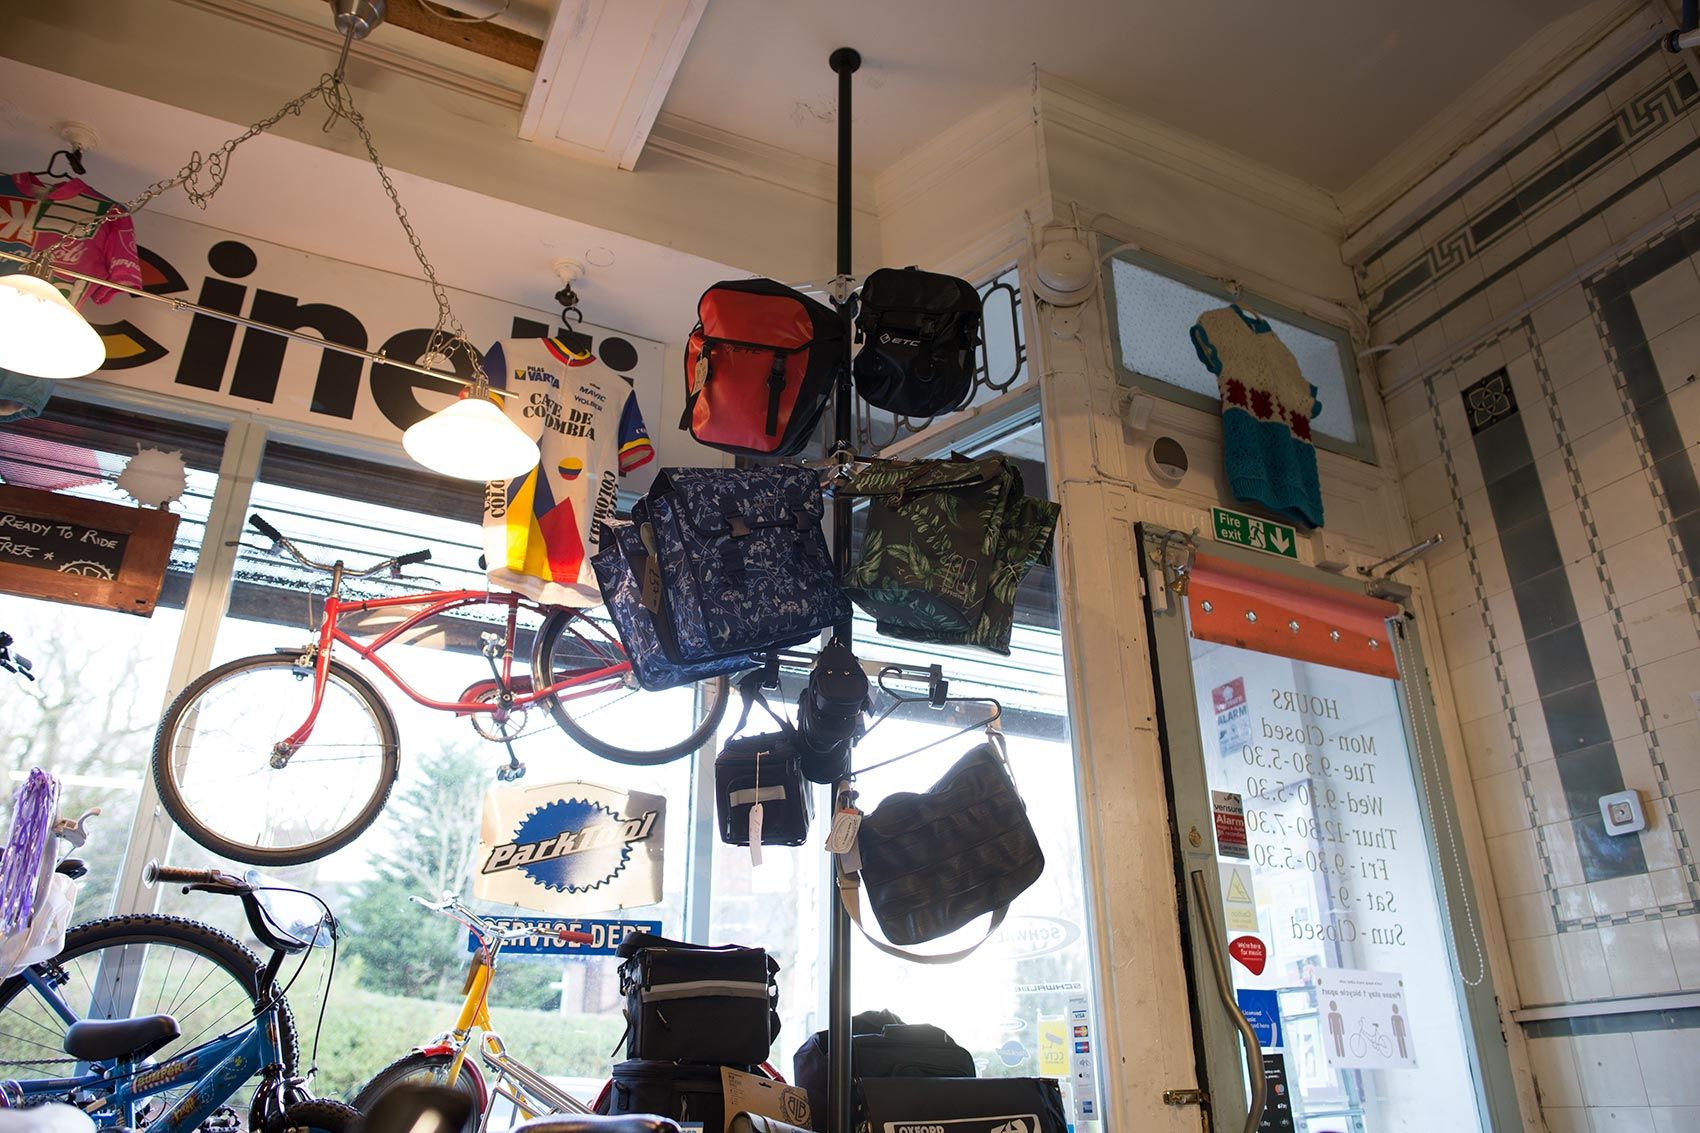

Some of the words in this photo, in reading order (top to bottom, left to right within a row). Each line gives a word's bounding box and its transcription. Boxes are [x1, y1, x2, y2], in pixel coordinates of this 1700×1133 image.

[528, 371, 560, 389] VARTA
[579, 386, 607, 402] MAVIC
[523, 405, 595, 441] COOMBIA
[569, 408, 593, 425] DE
[491, 480, 505, 518] COLO
[1220, 512, 1241, 528] Fire
[1221, 528, 1242, 541] exit
[1217, 705, 1247, 726] ALARM
[1217, 814, 1244, 827] Alarm
